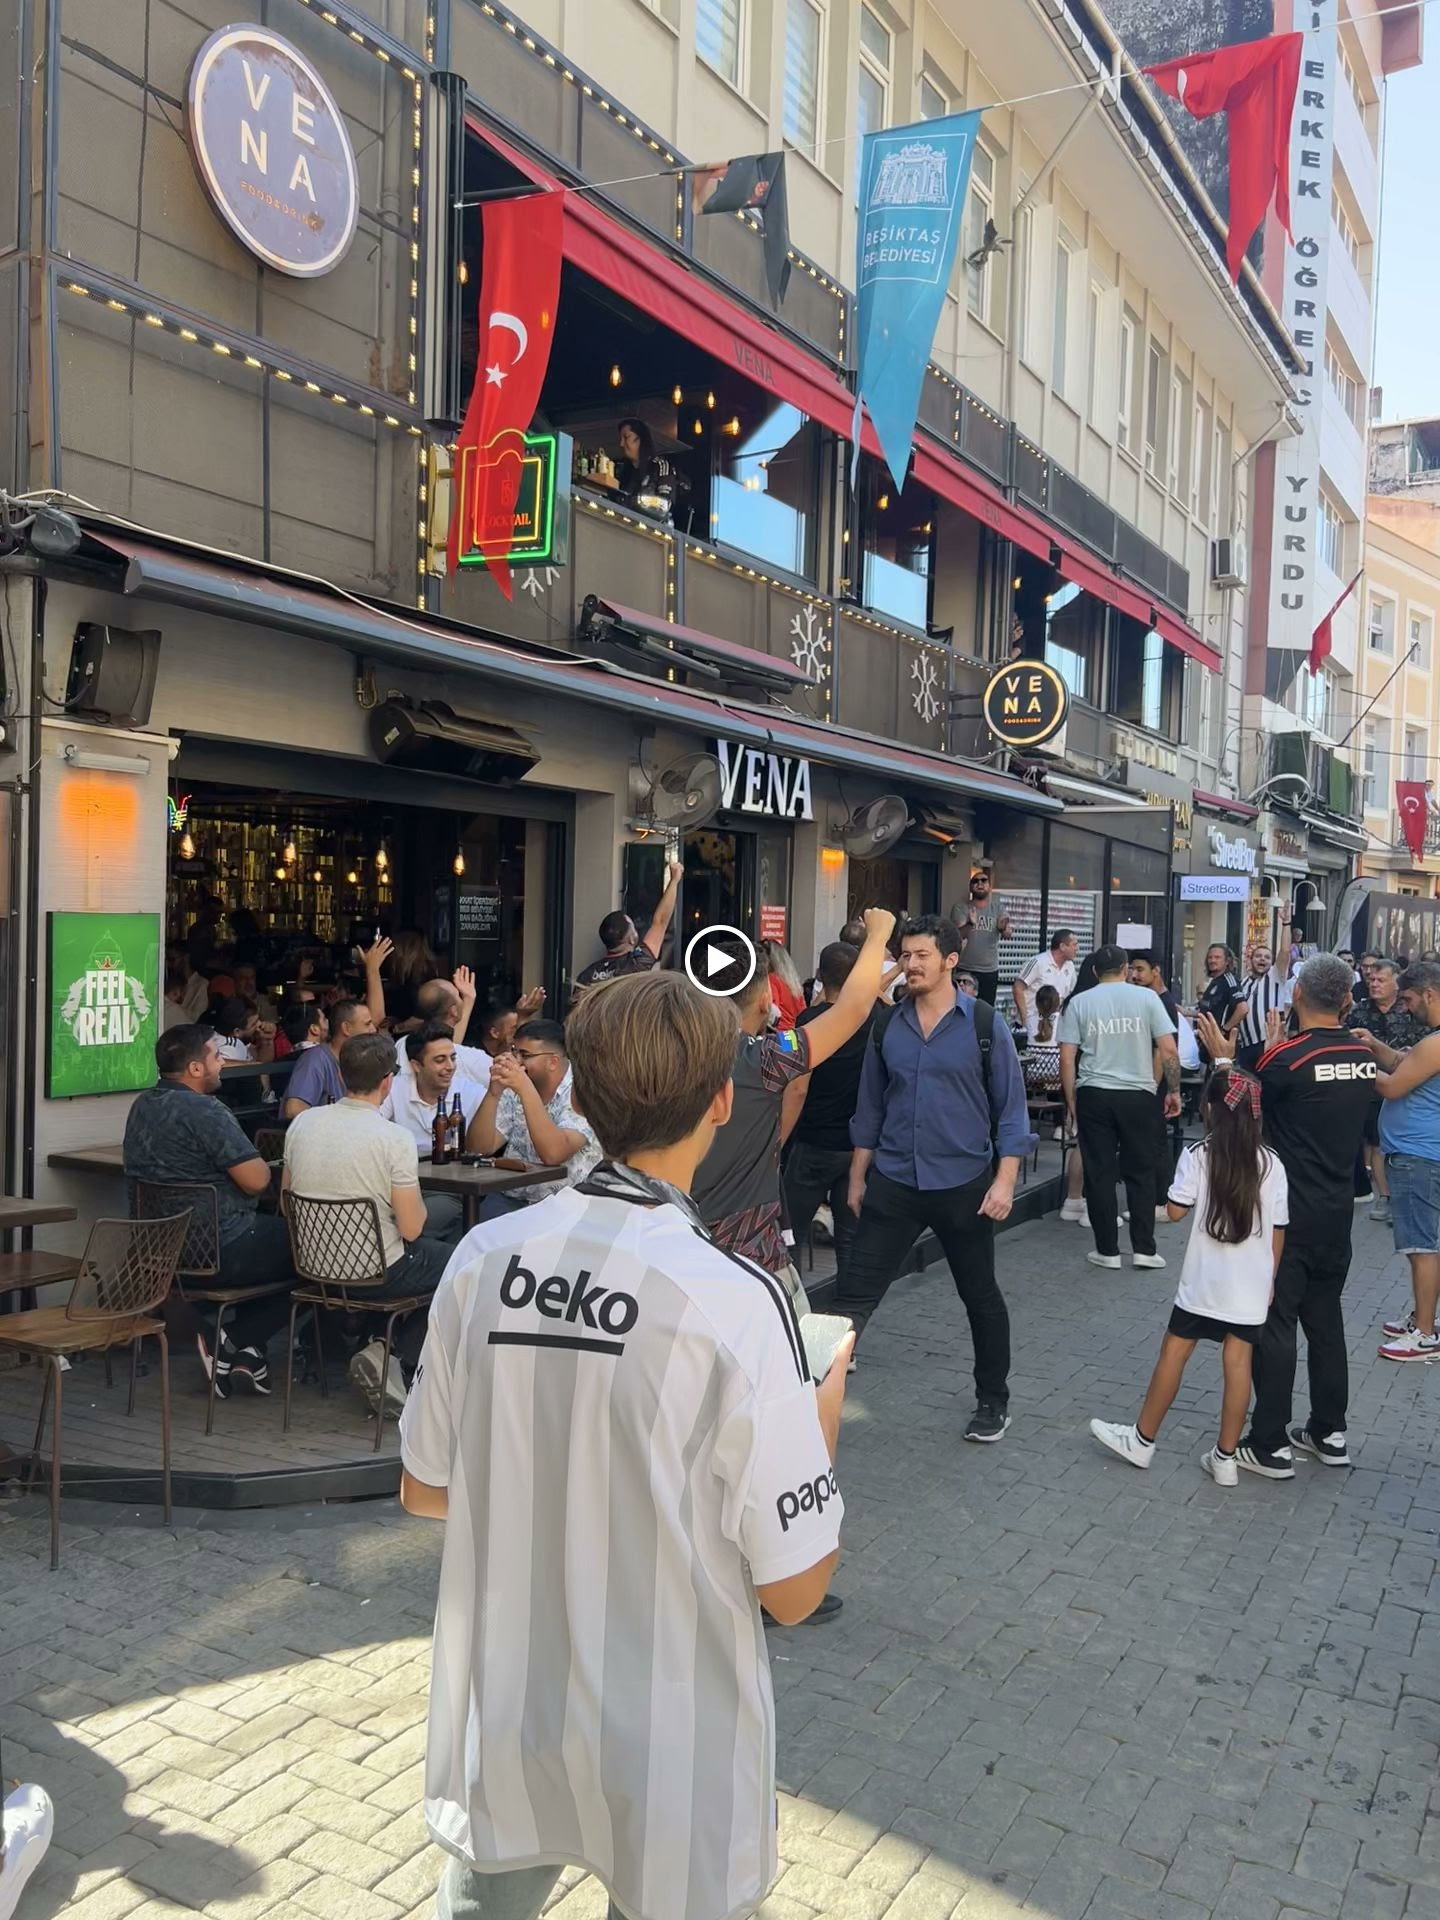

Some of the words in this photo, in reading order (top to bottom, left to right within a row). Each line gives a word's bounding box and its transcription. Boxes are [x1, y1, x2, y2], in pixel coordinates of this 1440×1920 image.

[1297, 60, 1325, 199] ERKEK
[865, 224, 941, 247] BEŞİKTAŞ
[733, 340, 775, 386] VENA
[1280, 476, 1309, 610] YURDU
[717, 739, 813, 820] VENA
[1187, 883, 1241, 895] StreetBox
[86, 970, 129, 1006] FEEL
[79, 1005, 135, 1046] REAL
[1087, 1016, 1142, 1037] AMIRI
[1314, 1061, 1377, 1082] BEKO
[499, 1254, 639, 1336] beko
